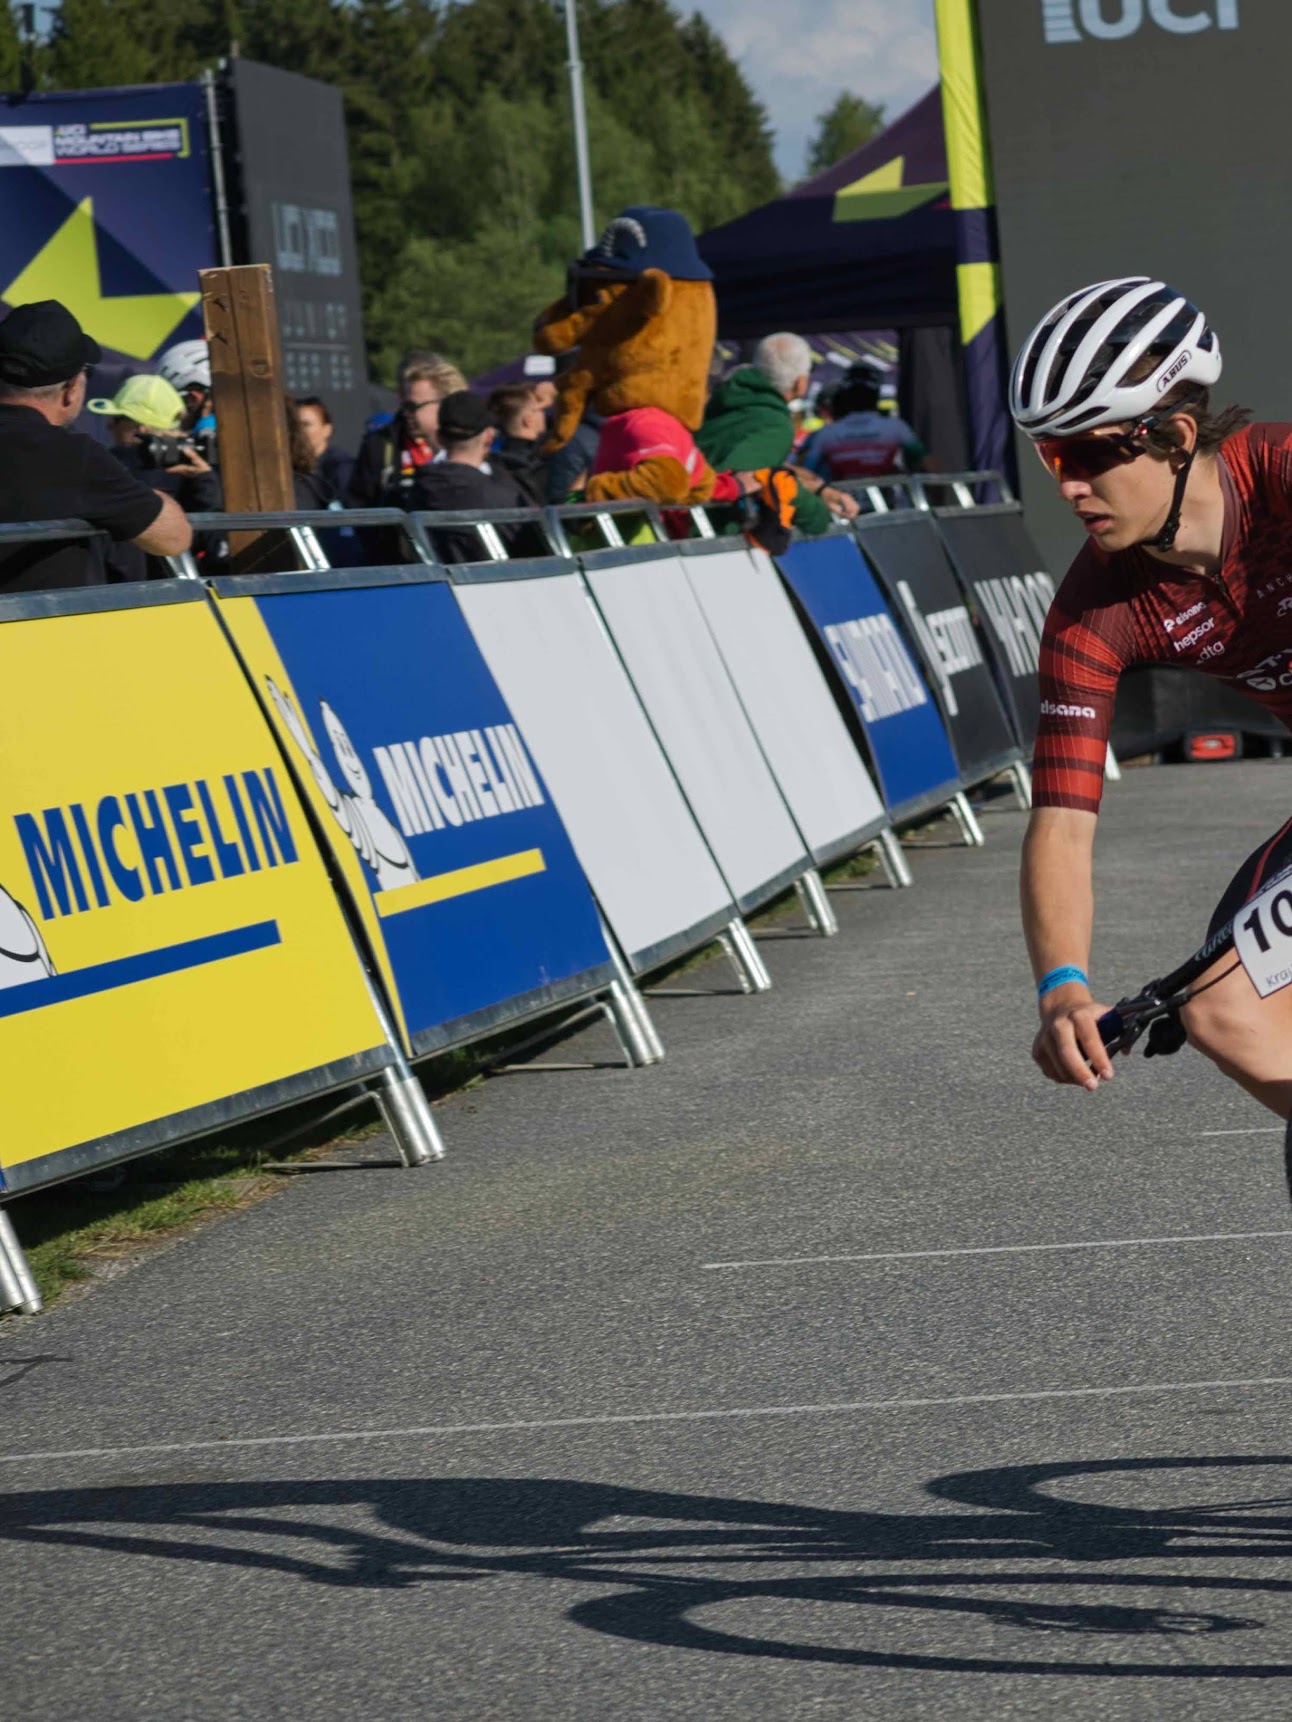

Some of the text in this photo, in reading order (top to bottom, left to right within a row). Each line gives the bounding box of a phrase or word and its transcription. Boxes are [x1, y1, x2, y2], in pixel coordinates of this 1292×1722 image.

[1163, 354, 1188, 388] ABUS
[1173, 616, 1216, 653] hepsor
[1200, 640, 1226, 661] dtg
[372, 723, 546, 837] MICHELIN
[13, 767, 299, 921] MICHELIN
